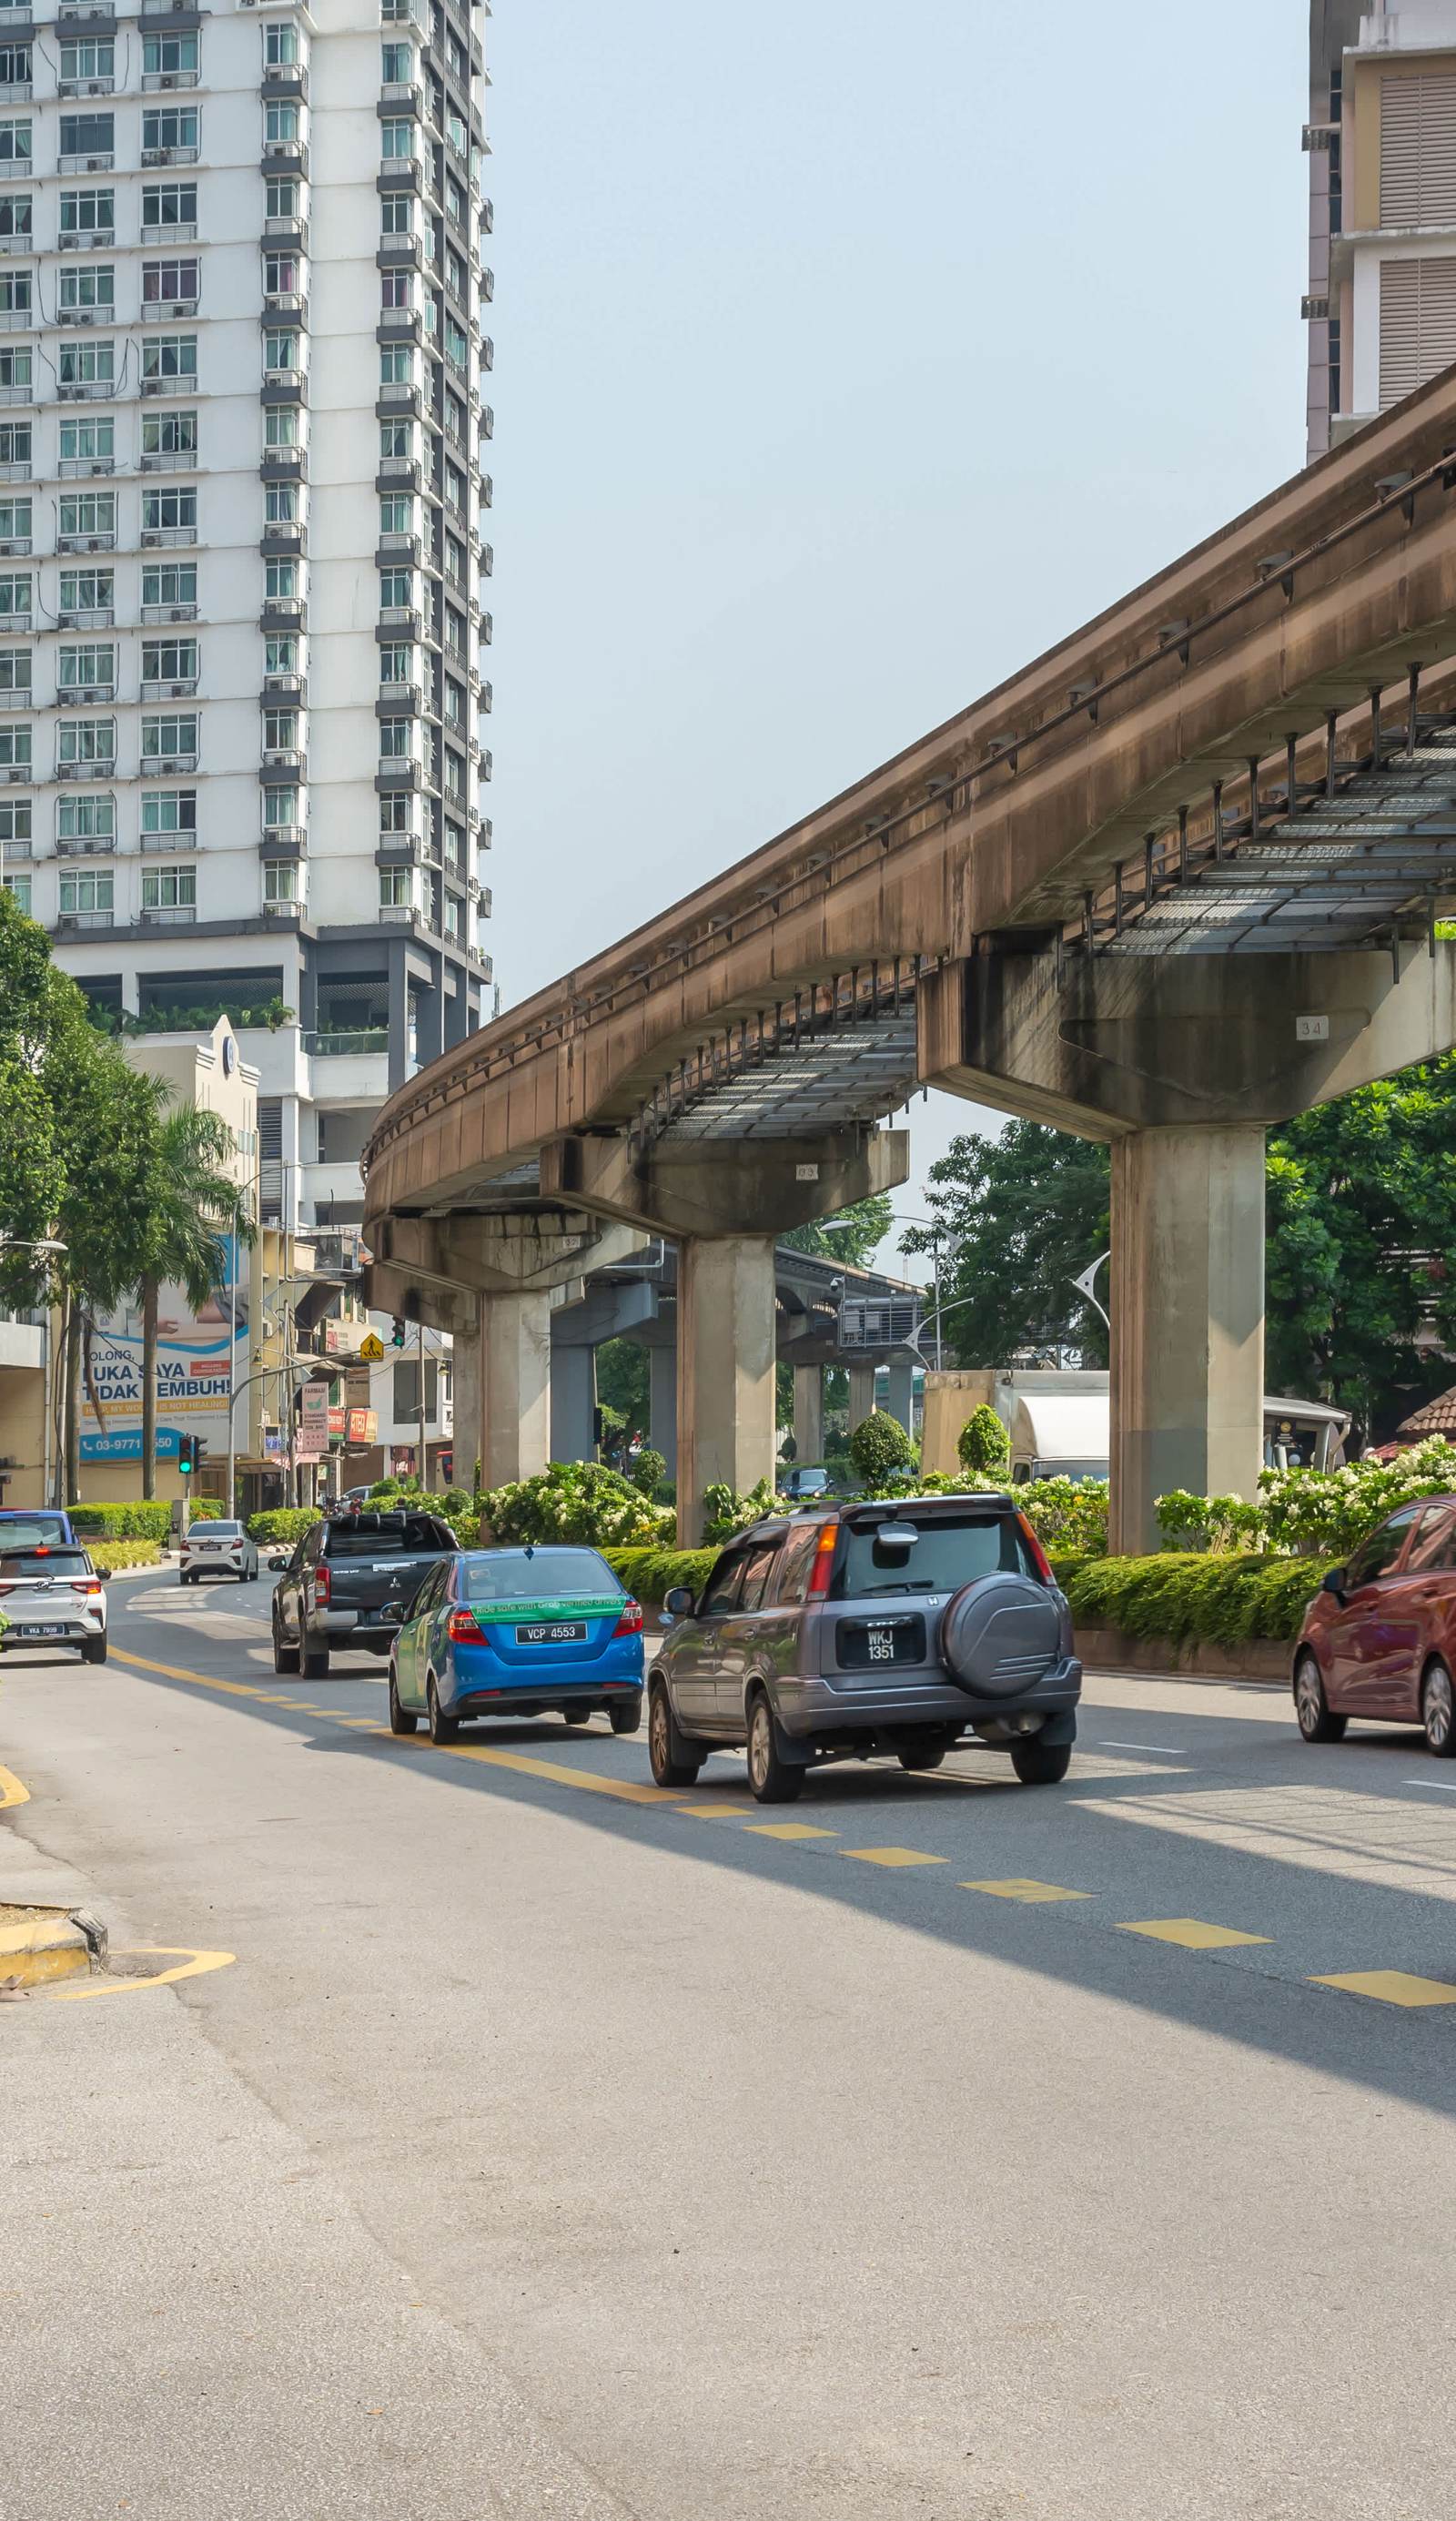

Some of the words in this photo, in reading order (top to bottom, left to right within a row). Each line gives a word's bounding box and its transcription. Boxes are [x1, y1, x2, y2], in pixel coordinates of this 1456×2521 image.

[1302, 1022, 1320, 1035] 34
[83, 1351, 135, 1362] OLONG,
[157, 1380, 230, 1397] EMBUH!
[96, 1439, 140, 1451] 03-9771
[518, 1603, 536, 1611] with
[538, 1600, 560, 1609] Grab
[561, 1598, 592, 1607] verified
[527, 1629, 546, 1639] VCP
[551, 1626, 576, 1638] 4553
[868, 1630, 893, 1645] WKJ
[868, 1645, 894, 1660] 1351
